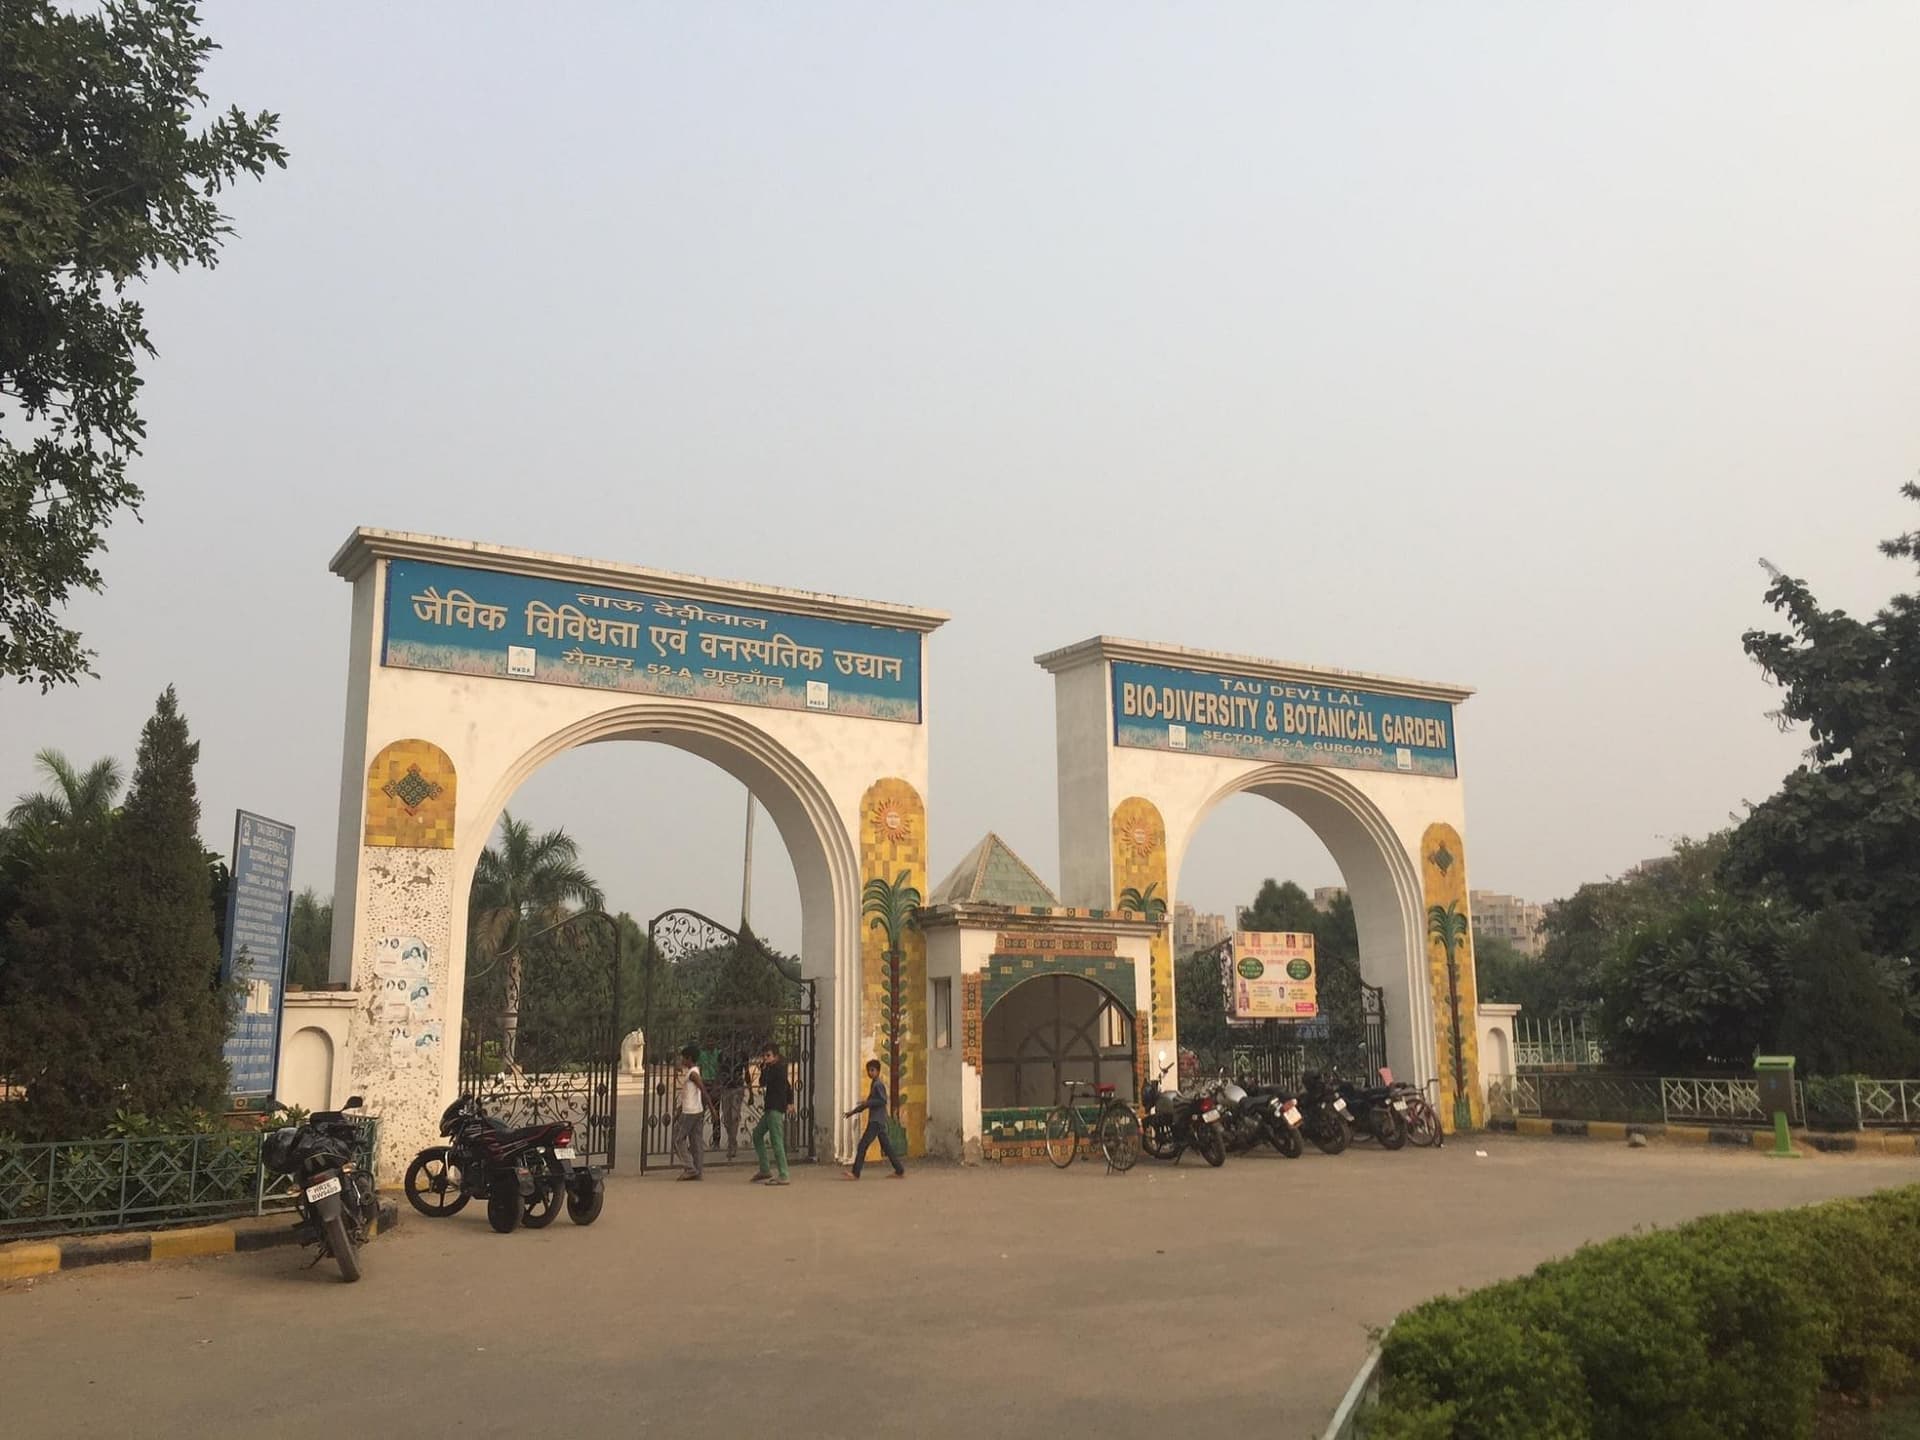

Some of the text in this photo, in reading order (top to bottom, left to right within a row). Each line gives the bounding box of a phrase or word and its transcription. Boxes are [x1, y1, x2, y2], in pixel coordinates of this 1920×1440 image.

[576, 593, 769, 631] ताऊ देवीलाल
[410, 586, 508, 632] जैविक
[524, 600, 640, 649] विविधता
[699, 633, 823, 671] वनस्पतिक
[833, 650, 902, 682] उद्यान
[647, 664, 692, 679] 52-A
[1219, 679, 1364, 707] TAU DEVI LAL
[1123, 682, 1447, 749] BIO-DIVERSITY & BOTANICAL GARDEN
[1313, 741, 1384, 757] GURGAON
